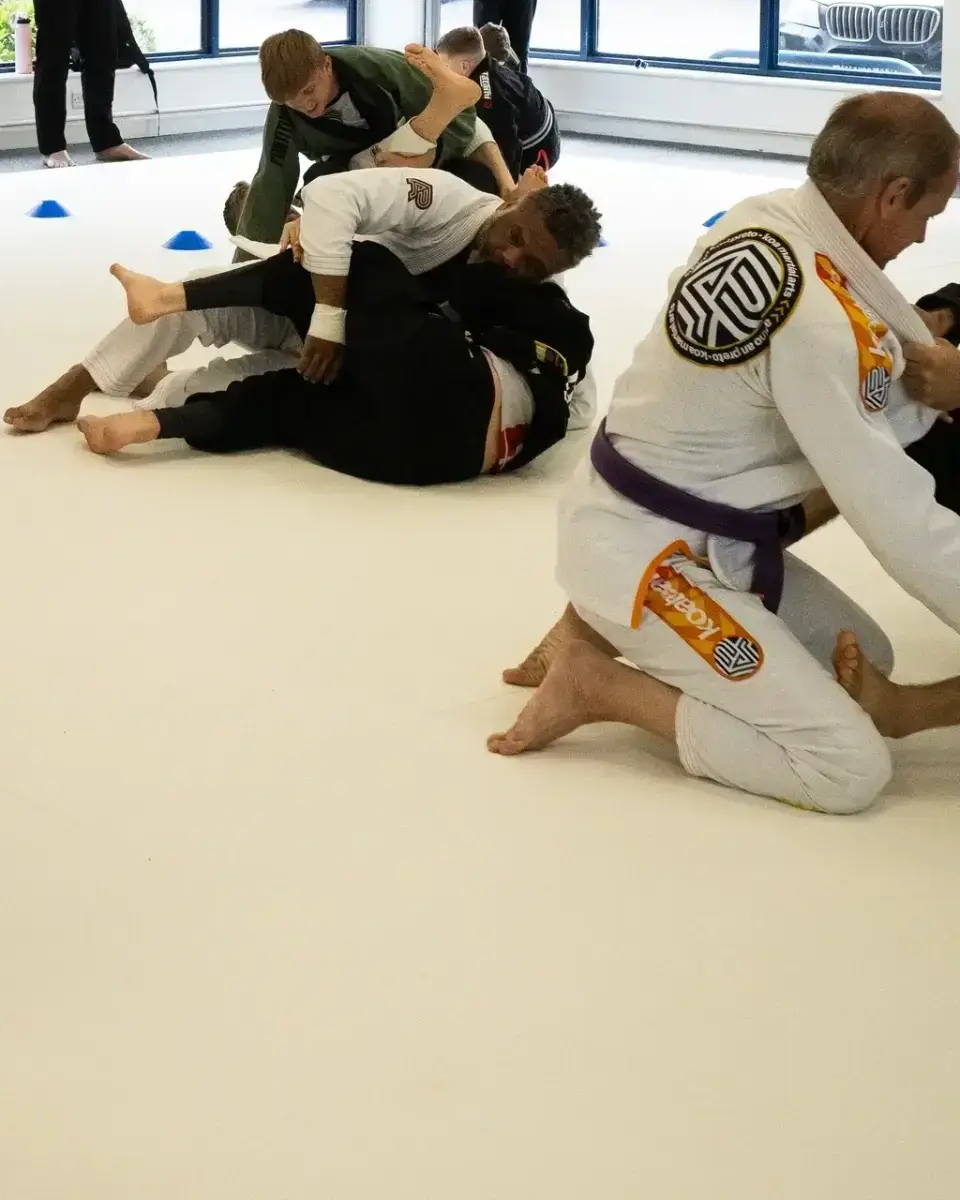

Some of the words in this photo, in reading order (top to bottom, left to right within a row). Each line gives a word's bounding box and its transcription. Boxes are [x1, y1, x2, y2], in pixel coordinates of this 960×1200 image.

[761, 233, 781, 248] koa
[777, 246, 800, 279] martial
[783, 277, 797, 298] arts
[688, 346, 708, 360] koa
[711, 346, 742, 363] preto
